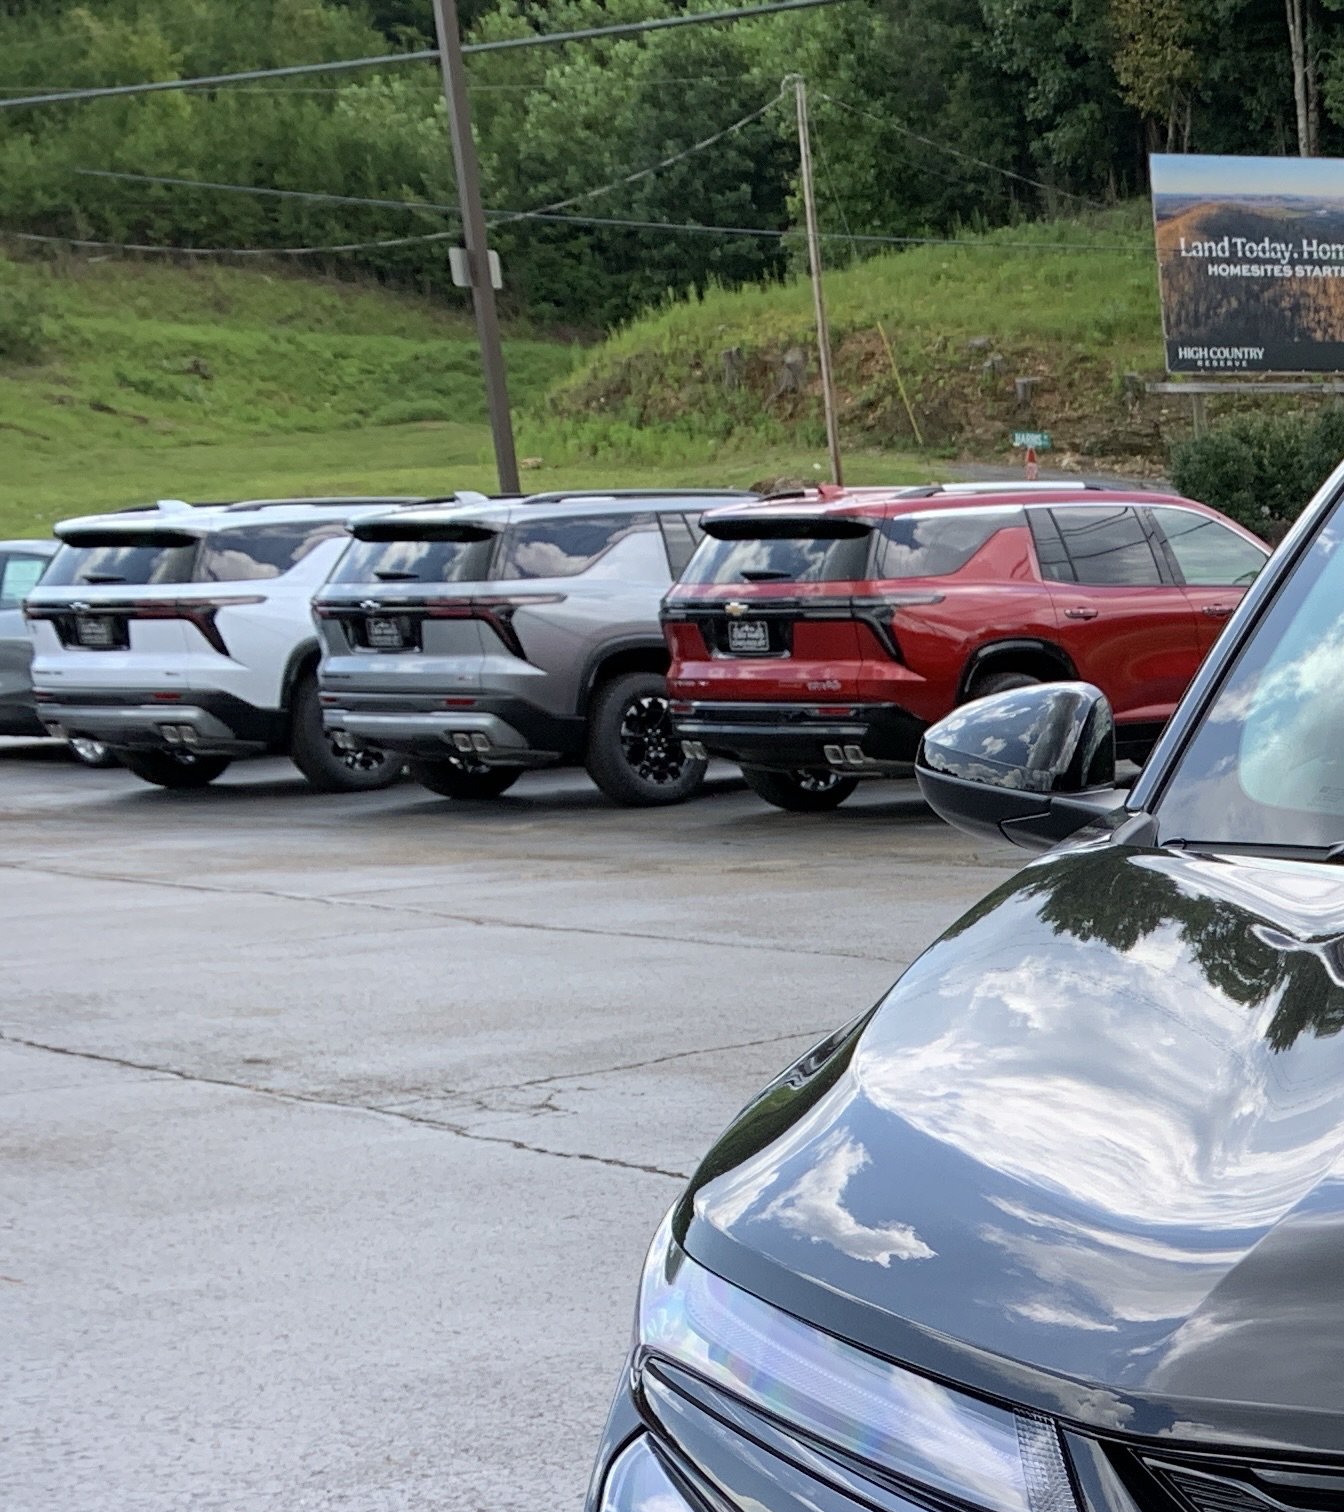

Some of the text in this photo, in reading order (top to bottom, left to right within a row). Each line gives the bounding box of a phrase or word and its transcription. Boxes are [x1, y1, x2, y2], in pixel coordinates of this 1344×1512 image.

[1180, 236, 1230, 258] Land
[1232, 237, 1298, 264] Today.
[1207, 263, 1293, 277] HOMESITES
[1178, 346, 1208, 360] HIGH
[1209, 346, 1265, 360] COUNTRY
